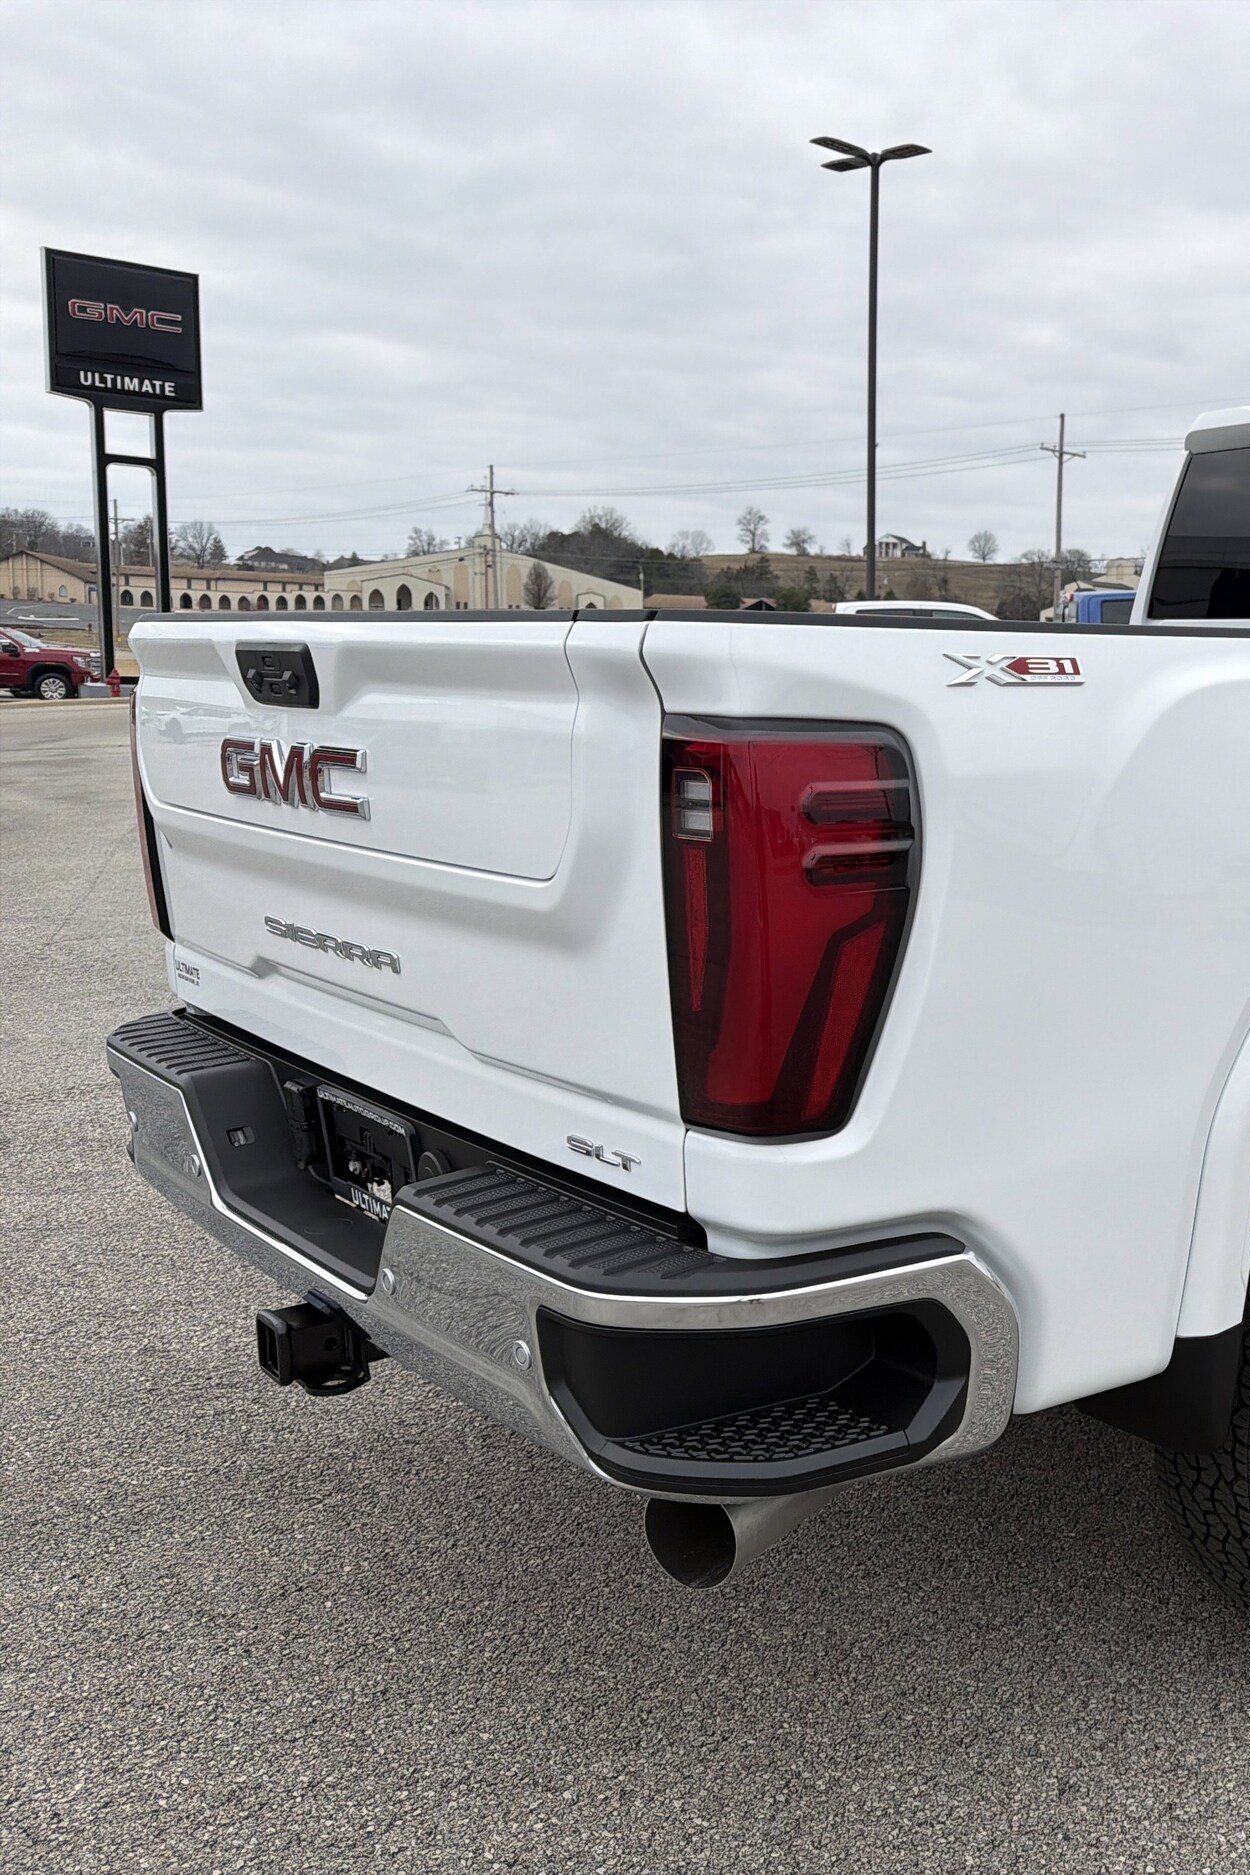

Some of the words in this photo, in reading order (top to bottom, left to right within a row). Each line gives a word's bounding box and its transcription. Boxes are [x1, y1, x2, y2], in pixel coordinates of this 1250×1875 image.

[68, 298, 182, 333] GMC
[79, 370, 176, 396] ULTIMATE
[220, 735, 371, 821] GMC
[264, 914, 401, 974] SIERRA
[566, 1134, 642, 1173] SLT
